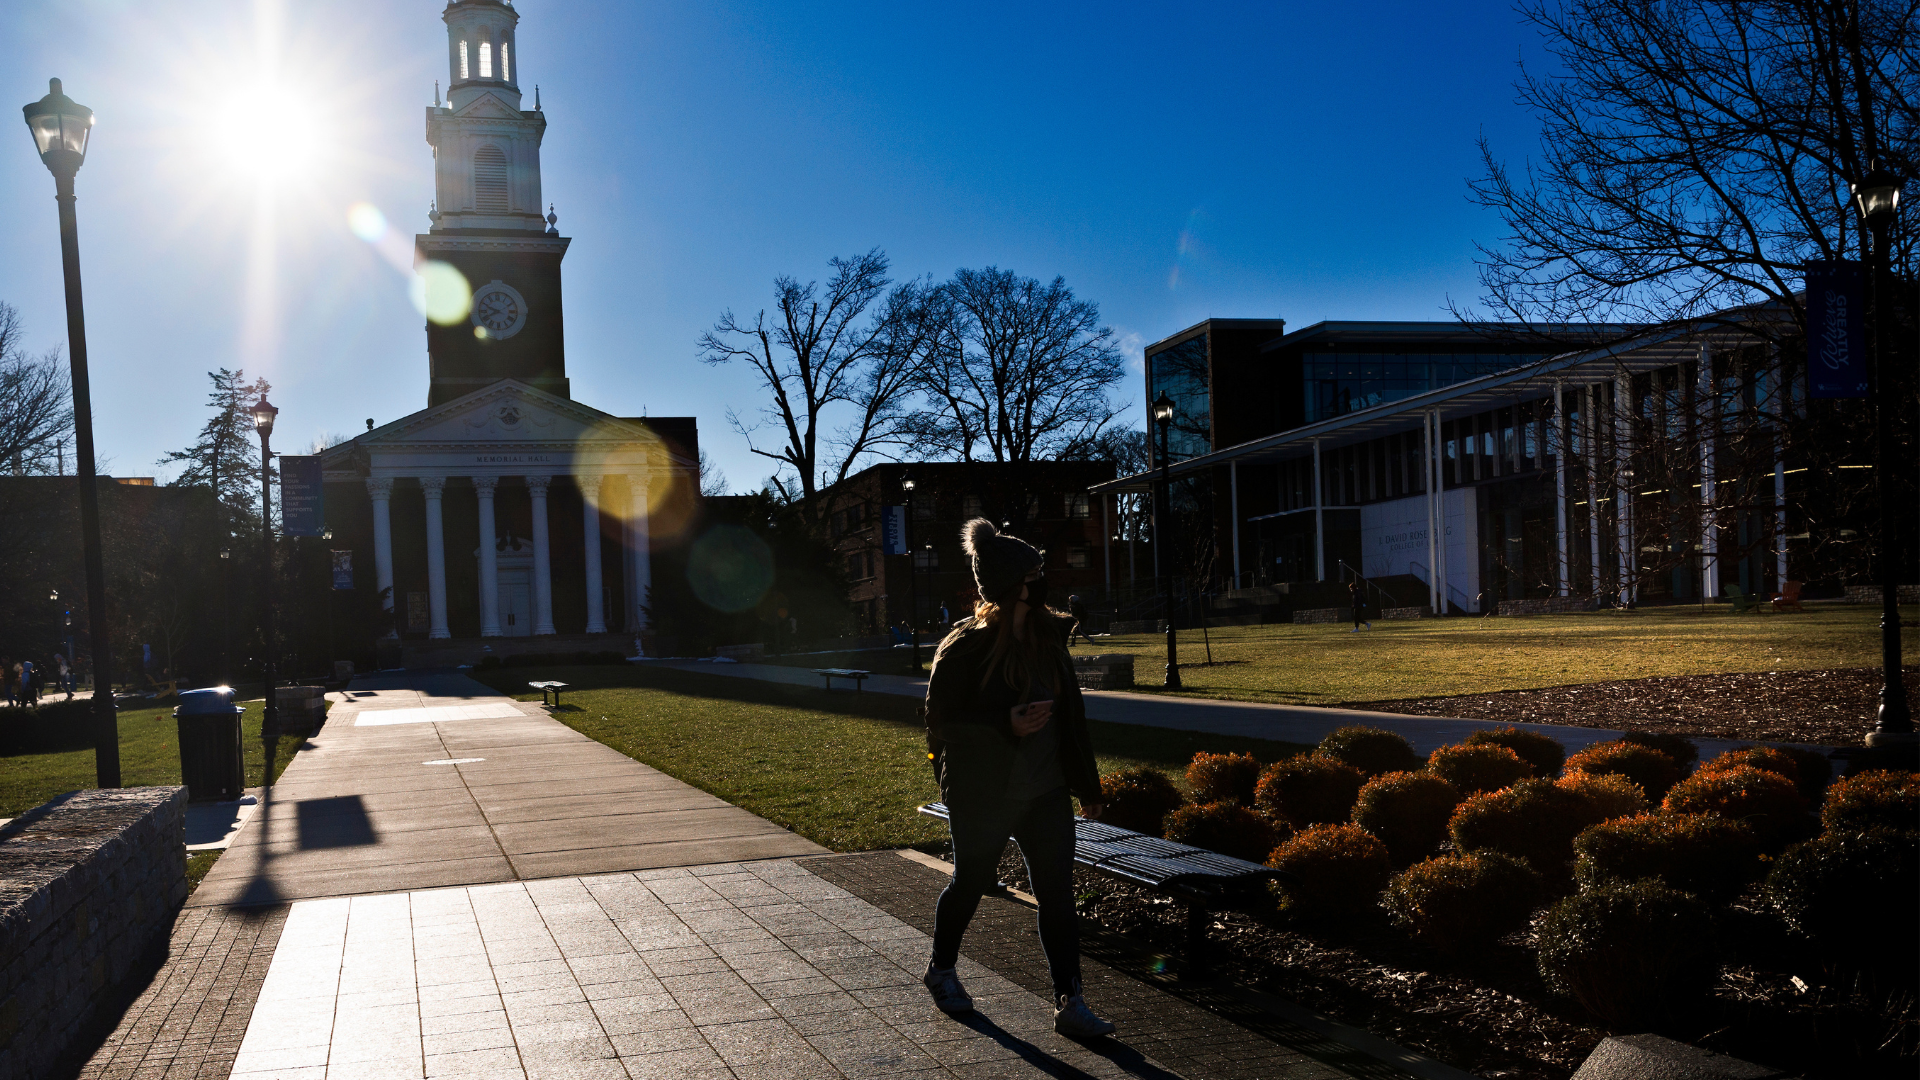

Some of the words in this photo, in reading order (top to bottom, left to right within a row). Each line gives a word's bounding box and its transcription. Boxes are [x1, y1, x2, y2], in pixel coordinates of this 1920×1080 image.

[1820, 289, 1840, 370] Achieve
[1836, 294, 1849, 366] GREATLY
[1385, 532, 1408, 544] DAVID
[1390, 541, 1415, 551] COLLEGE
